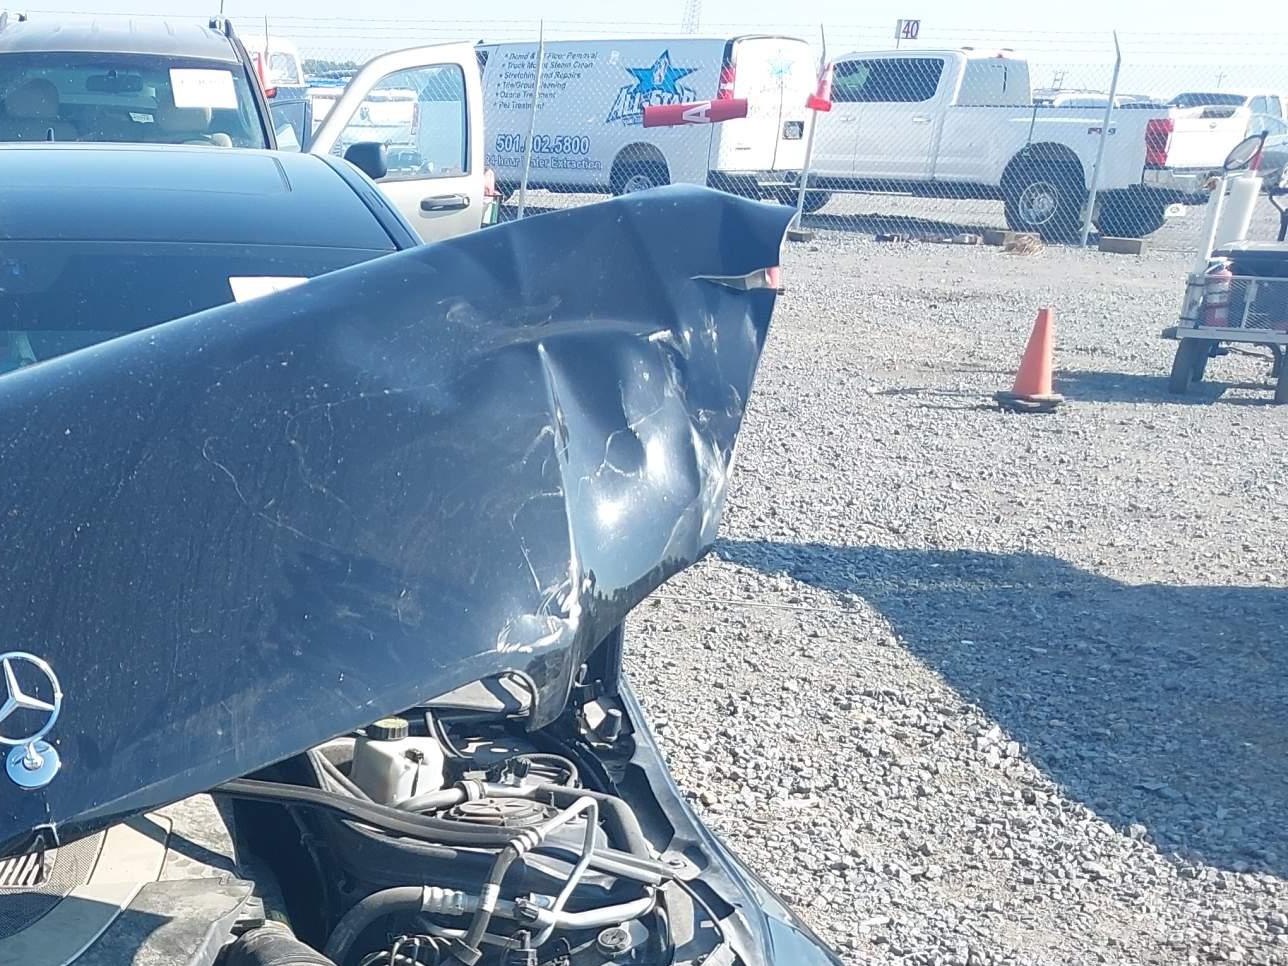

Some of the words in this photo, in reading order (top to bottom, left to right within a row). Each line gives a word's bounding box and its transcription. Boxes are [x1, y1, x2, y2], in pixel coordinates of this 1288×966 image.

[902, 20, 920, 39] 40
[537, 81, 566, 90] leaning
[512, 101, 545, 109] Treatmnt
[496, 134, 590, 154] 501.02.5800
[551, 157, 602, 170] Extraction
